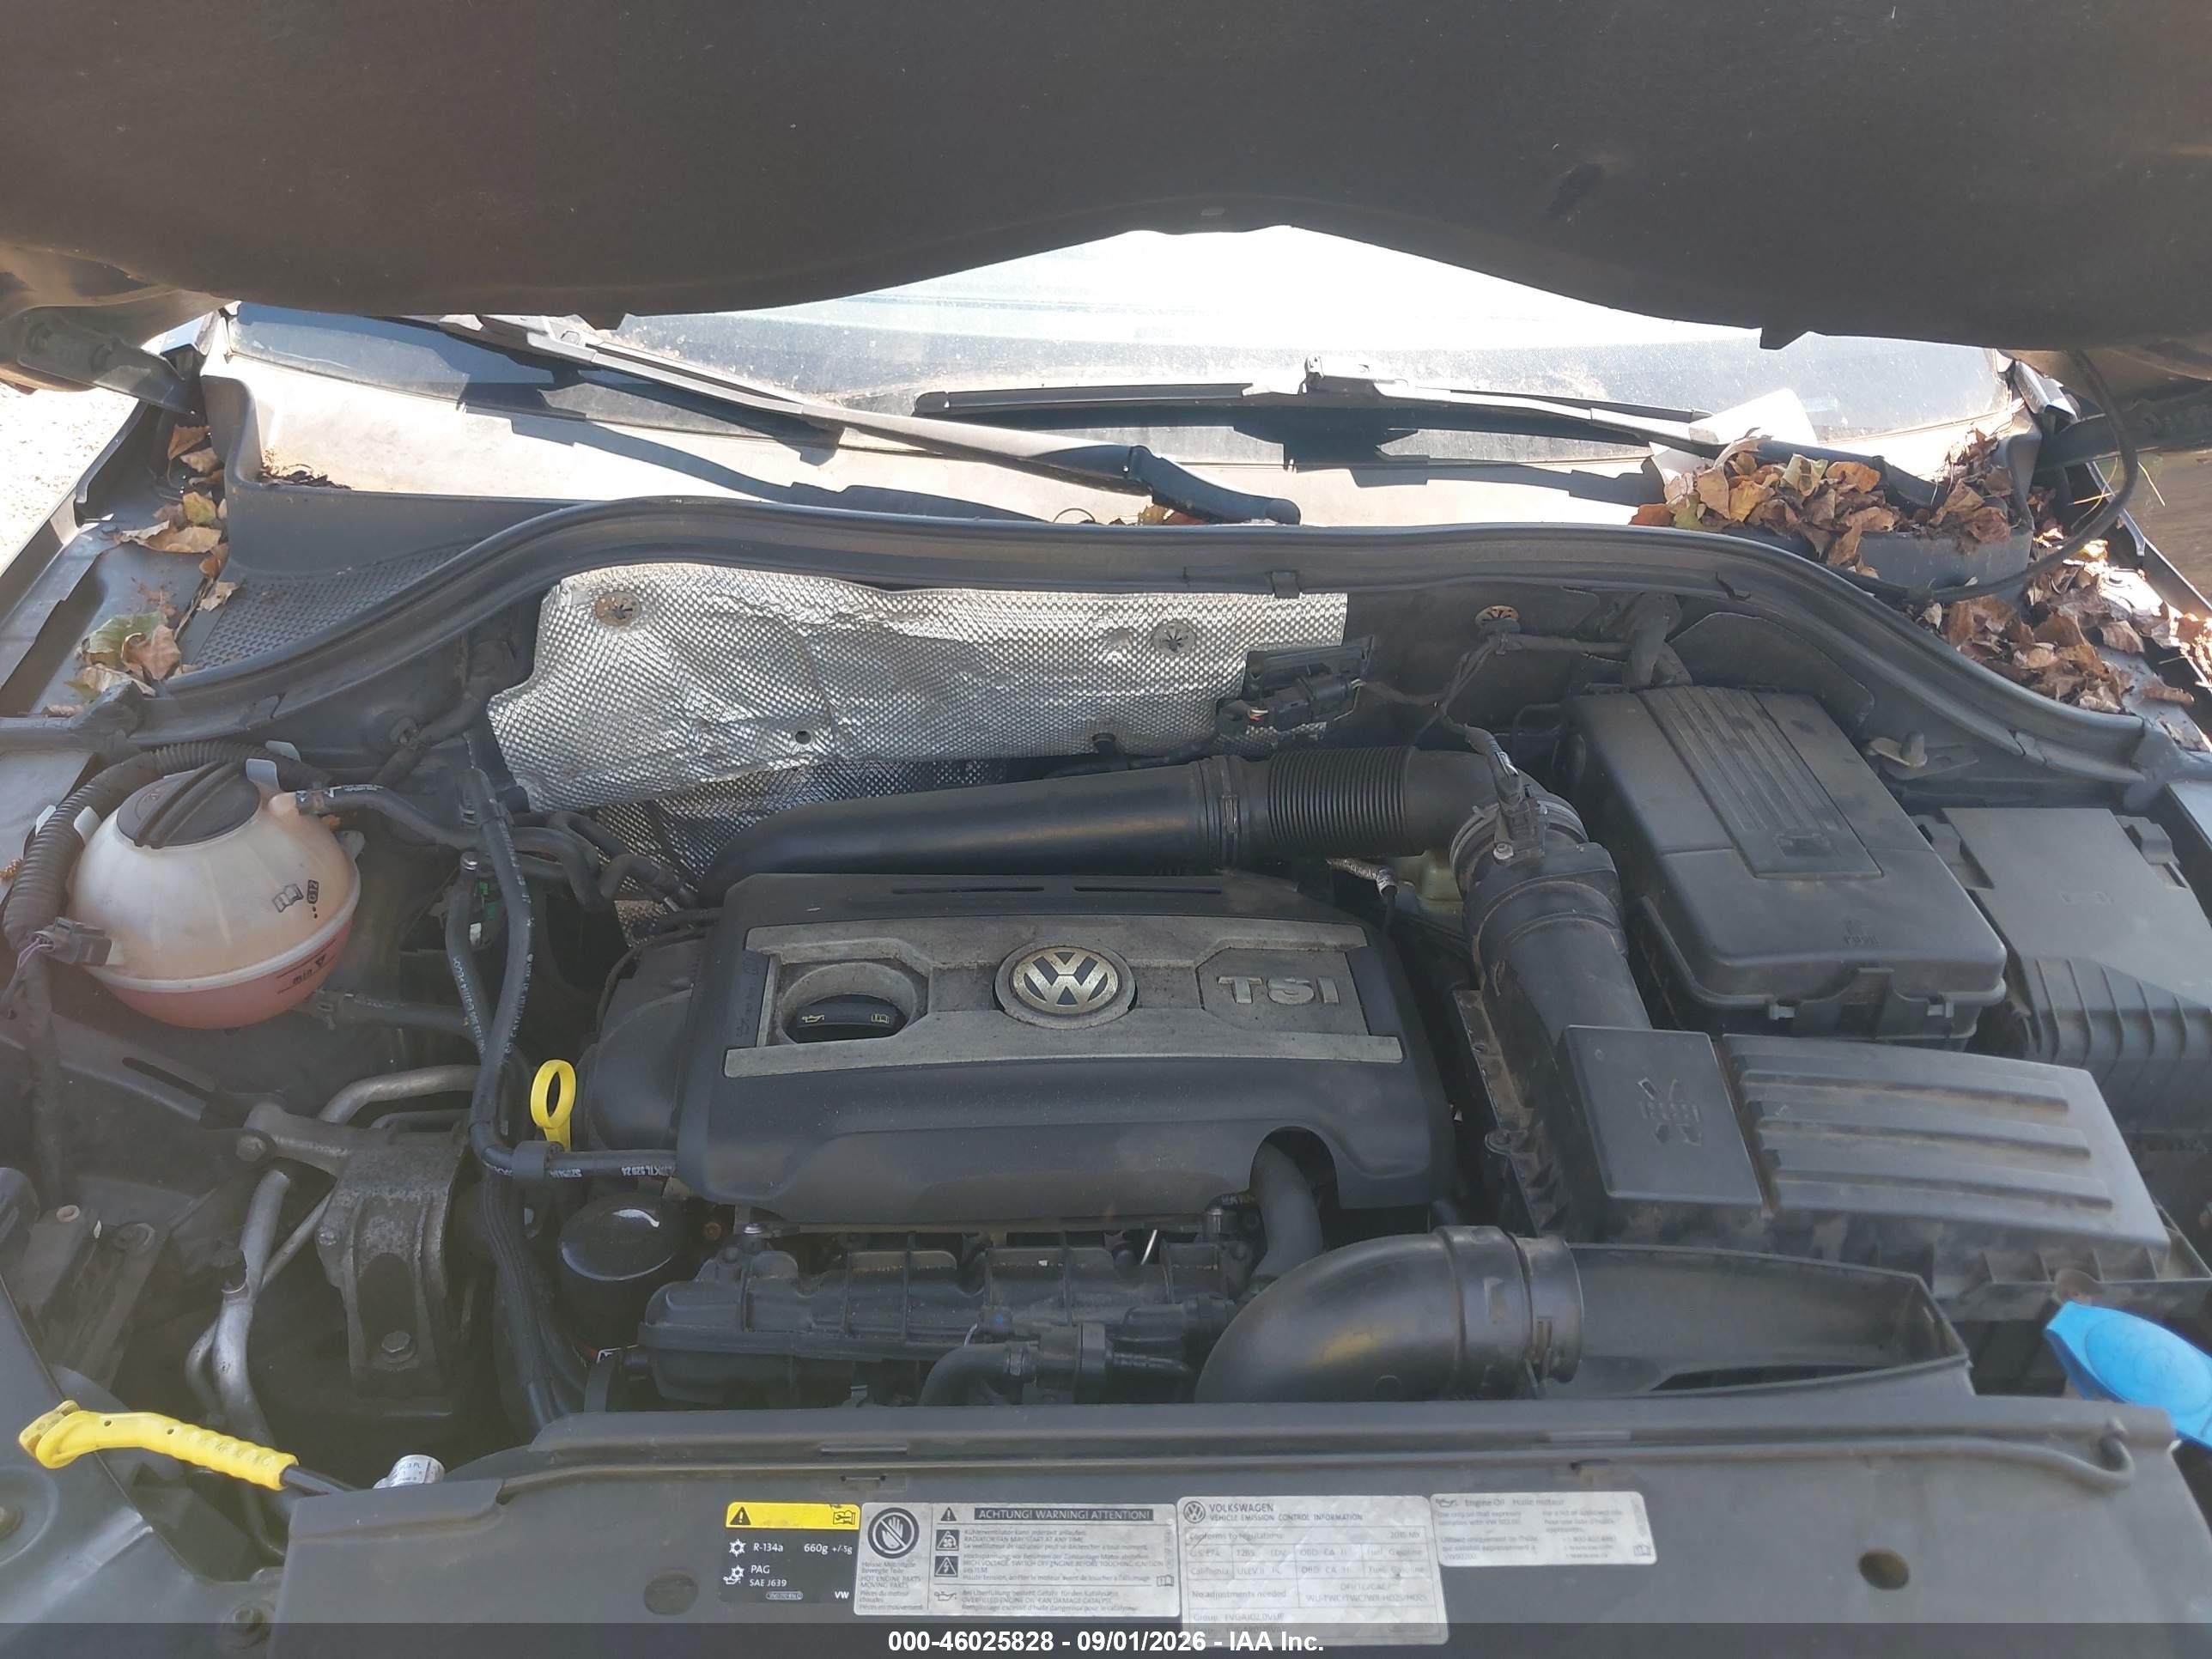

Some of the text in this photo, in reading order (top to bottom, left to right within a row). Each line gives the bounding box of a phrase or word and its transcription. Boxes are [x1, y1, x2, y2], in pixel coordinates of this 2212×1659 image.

[1218, 975, 1340, 1005] TSI
[1209, 1504, 1274, 1512] VOLKSWAGEN
[979, 1510, 1150, 1519] ACHTUNG! WARNING! ATTENTION!
[753, 1543, 784, 1552] R-134a
[804, 1543, 828, 1555] 660g
[750, 1565, 770, 1574] PAG
